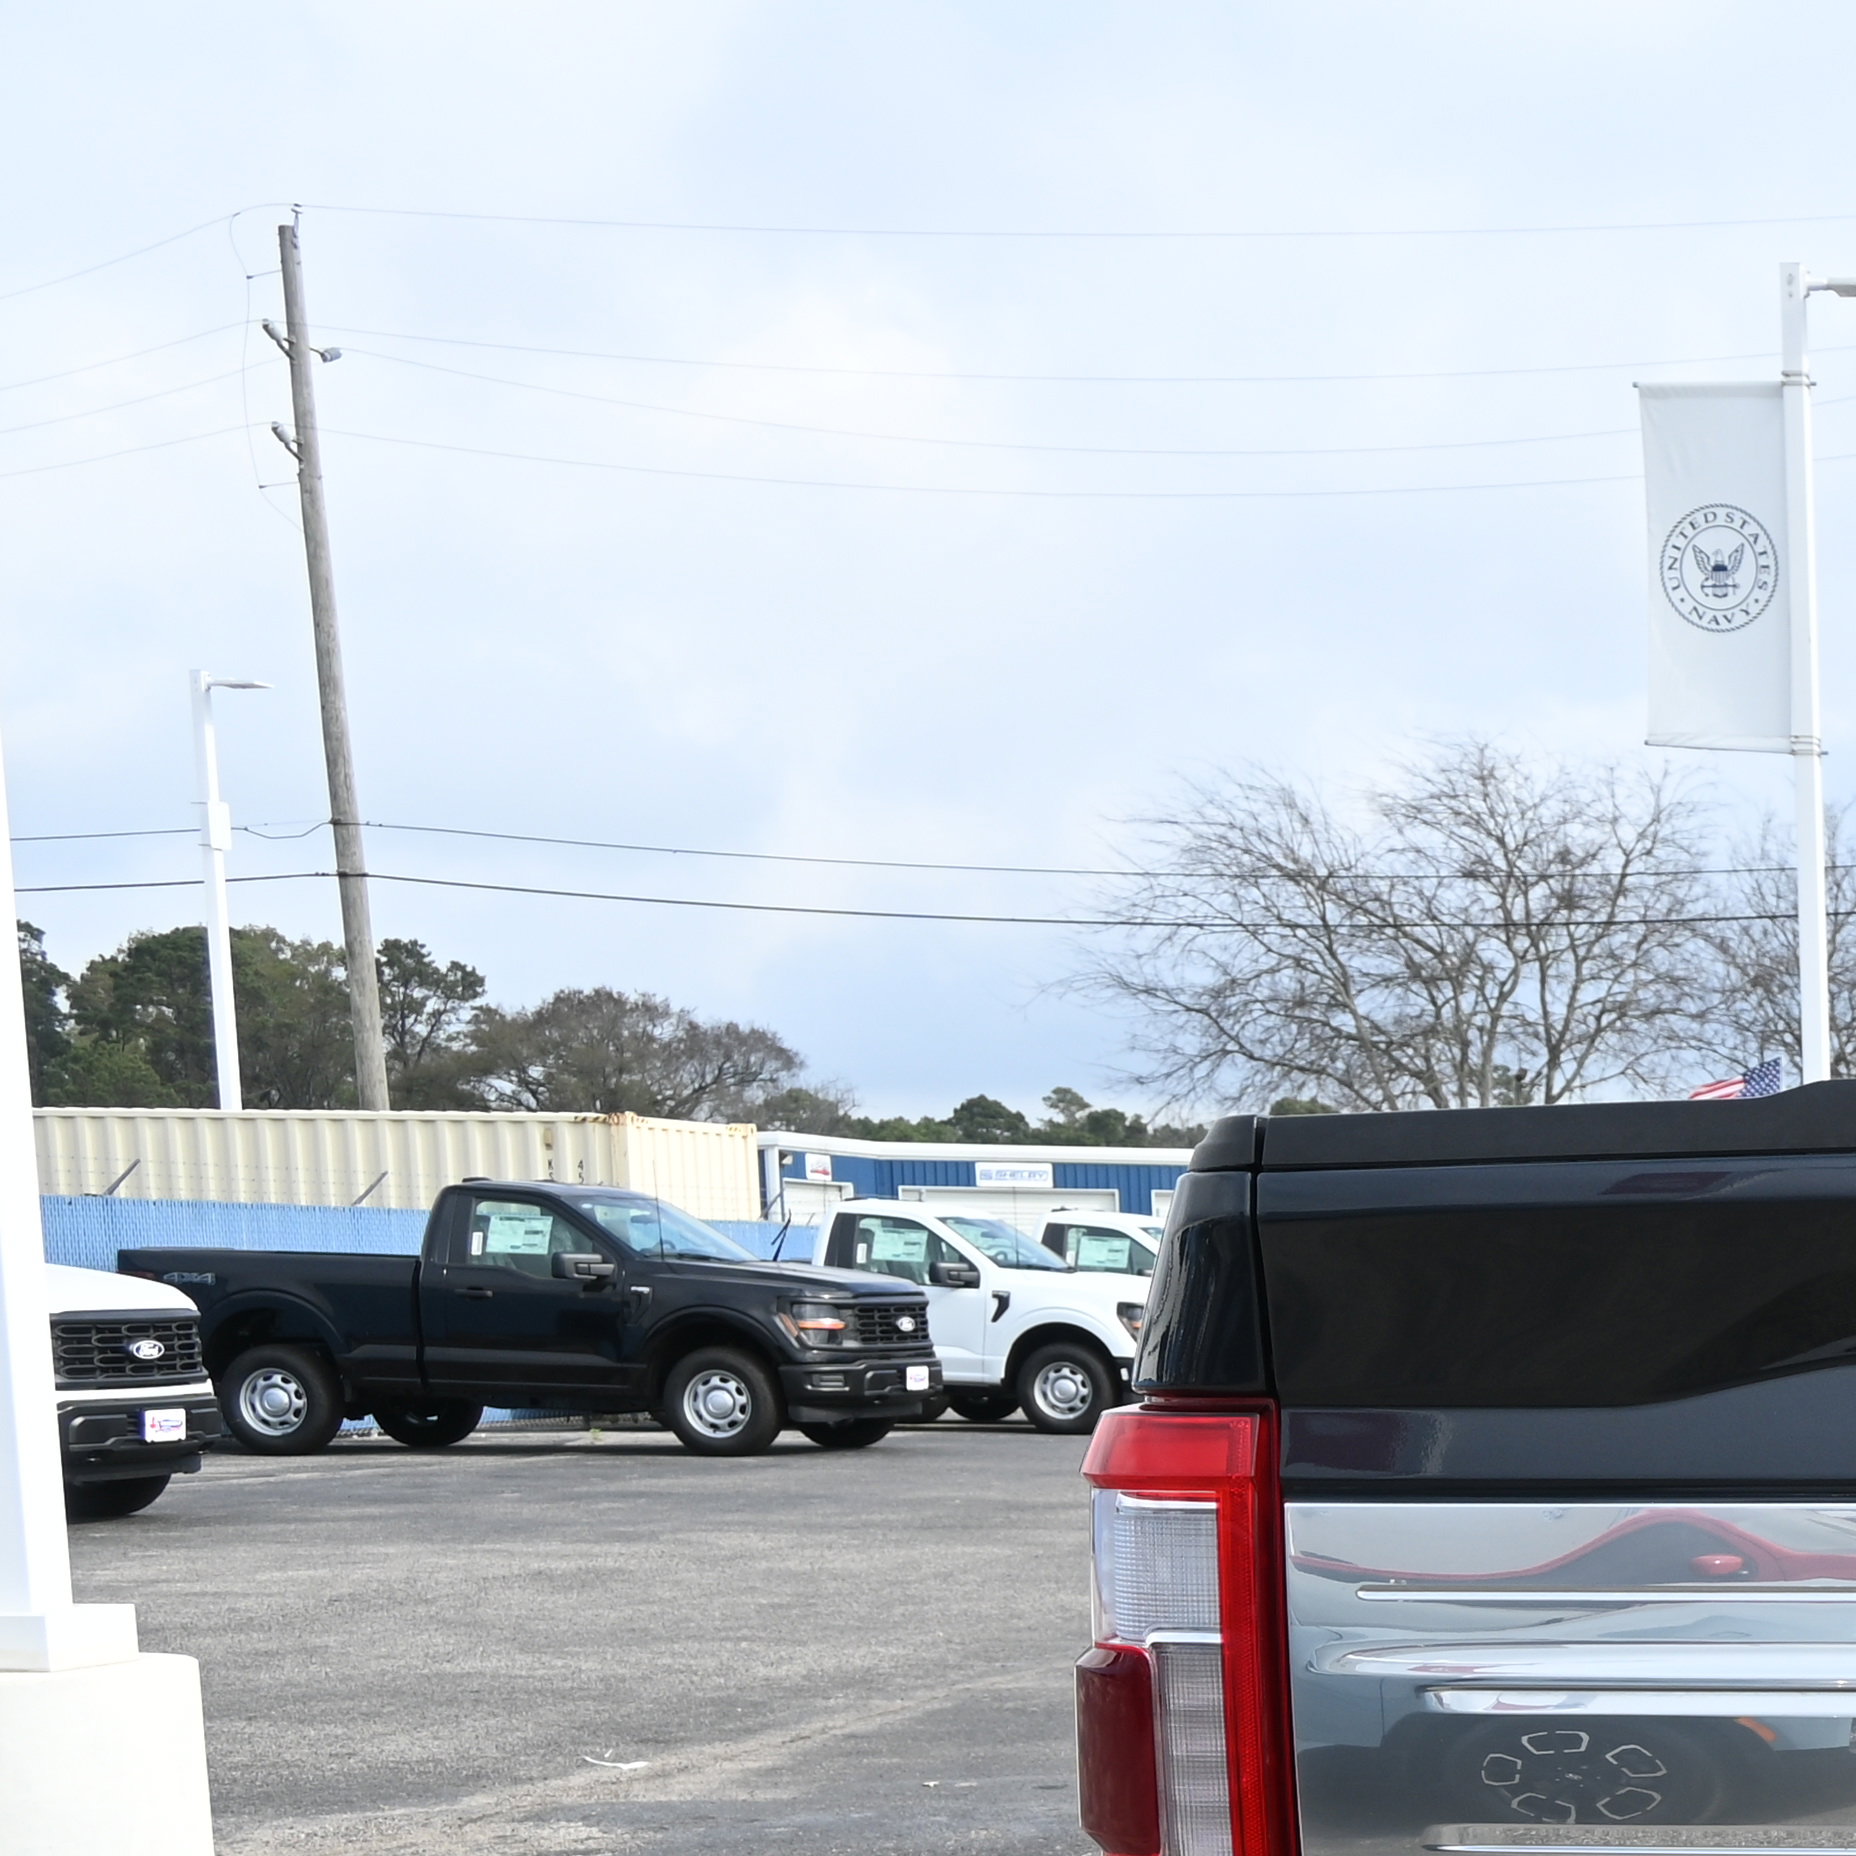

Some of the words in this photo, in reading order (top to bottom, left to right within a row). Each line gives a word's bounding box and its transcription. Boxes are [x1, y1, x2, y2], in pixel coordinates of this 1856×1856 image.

[1667, 510, 1717, 592] UNITED
[1724, 510, 1771, 591] STATES
[1687, 603, 1752, 627] NAVY
